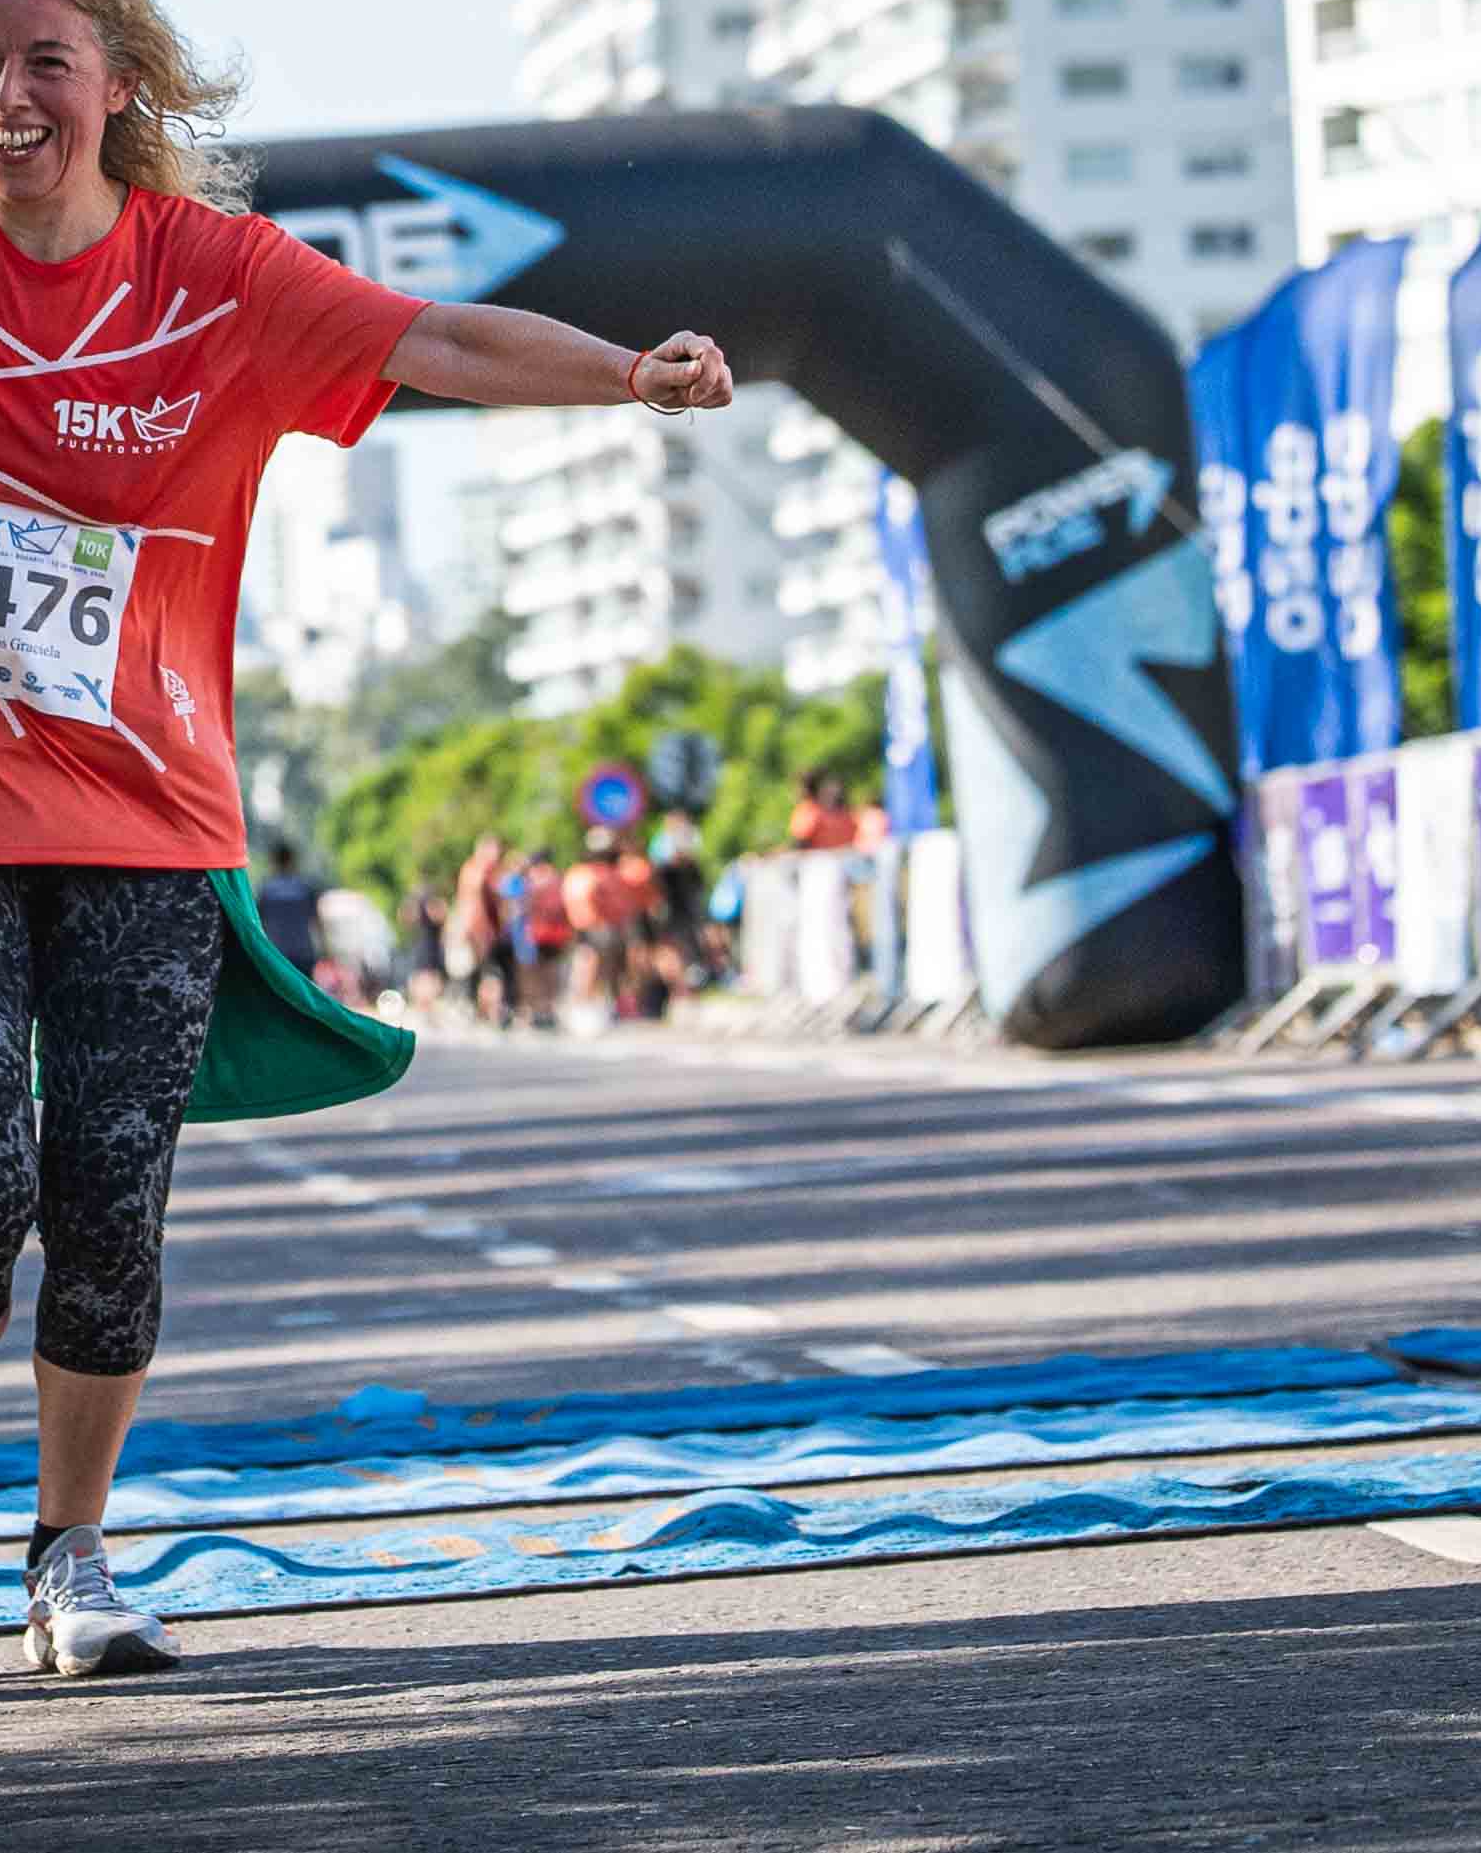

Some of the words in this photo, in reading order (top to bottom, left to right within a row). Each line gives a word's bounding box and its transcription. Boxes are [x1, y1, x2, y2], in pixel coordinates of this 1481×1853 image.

[53, 399, 128, 441] 15K
[57, 437, 125, 454] PUERTO
[131, 440, 176, 454] NORT
[79, 539, 109, 559] 10K
